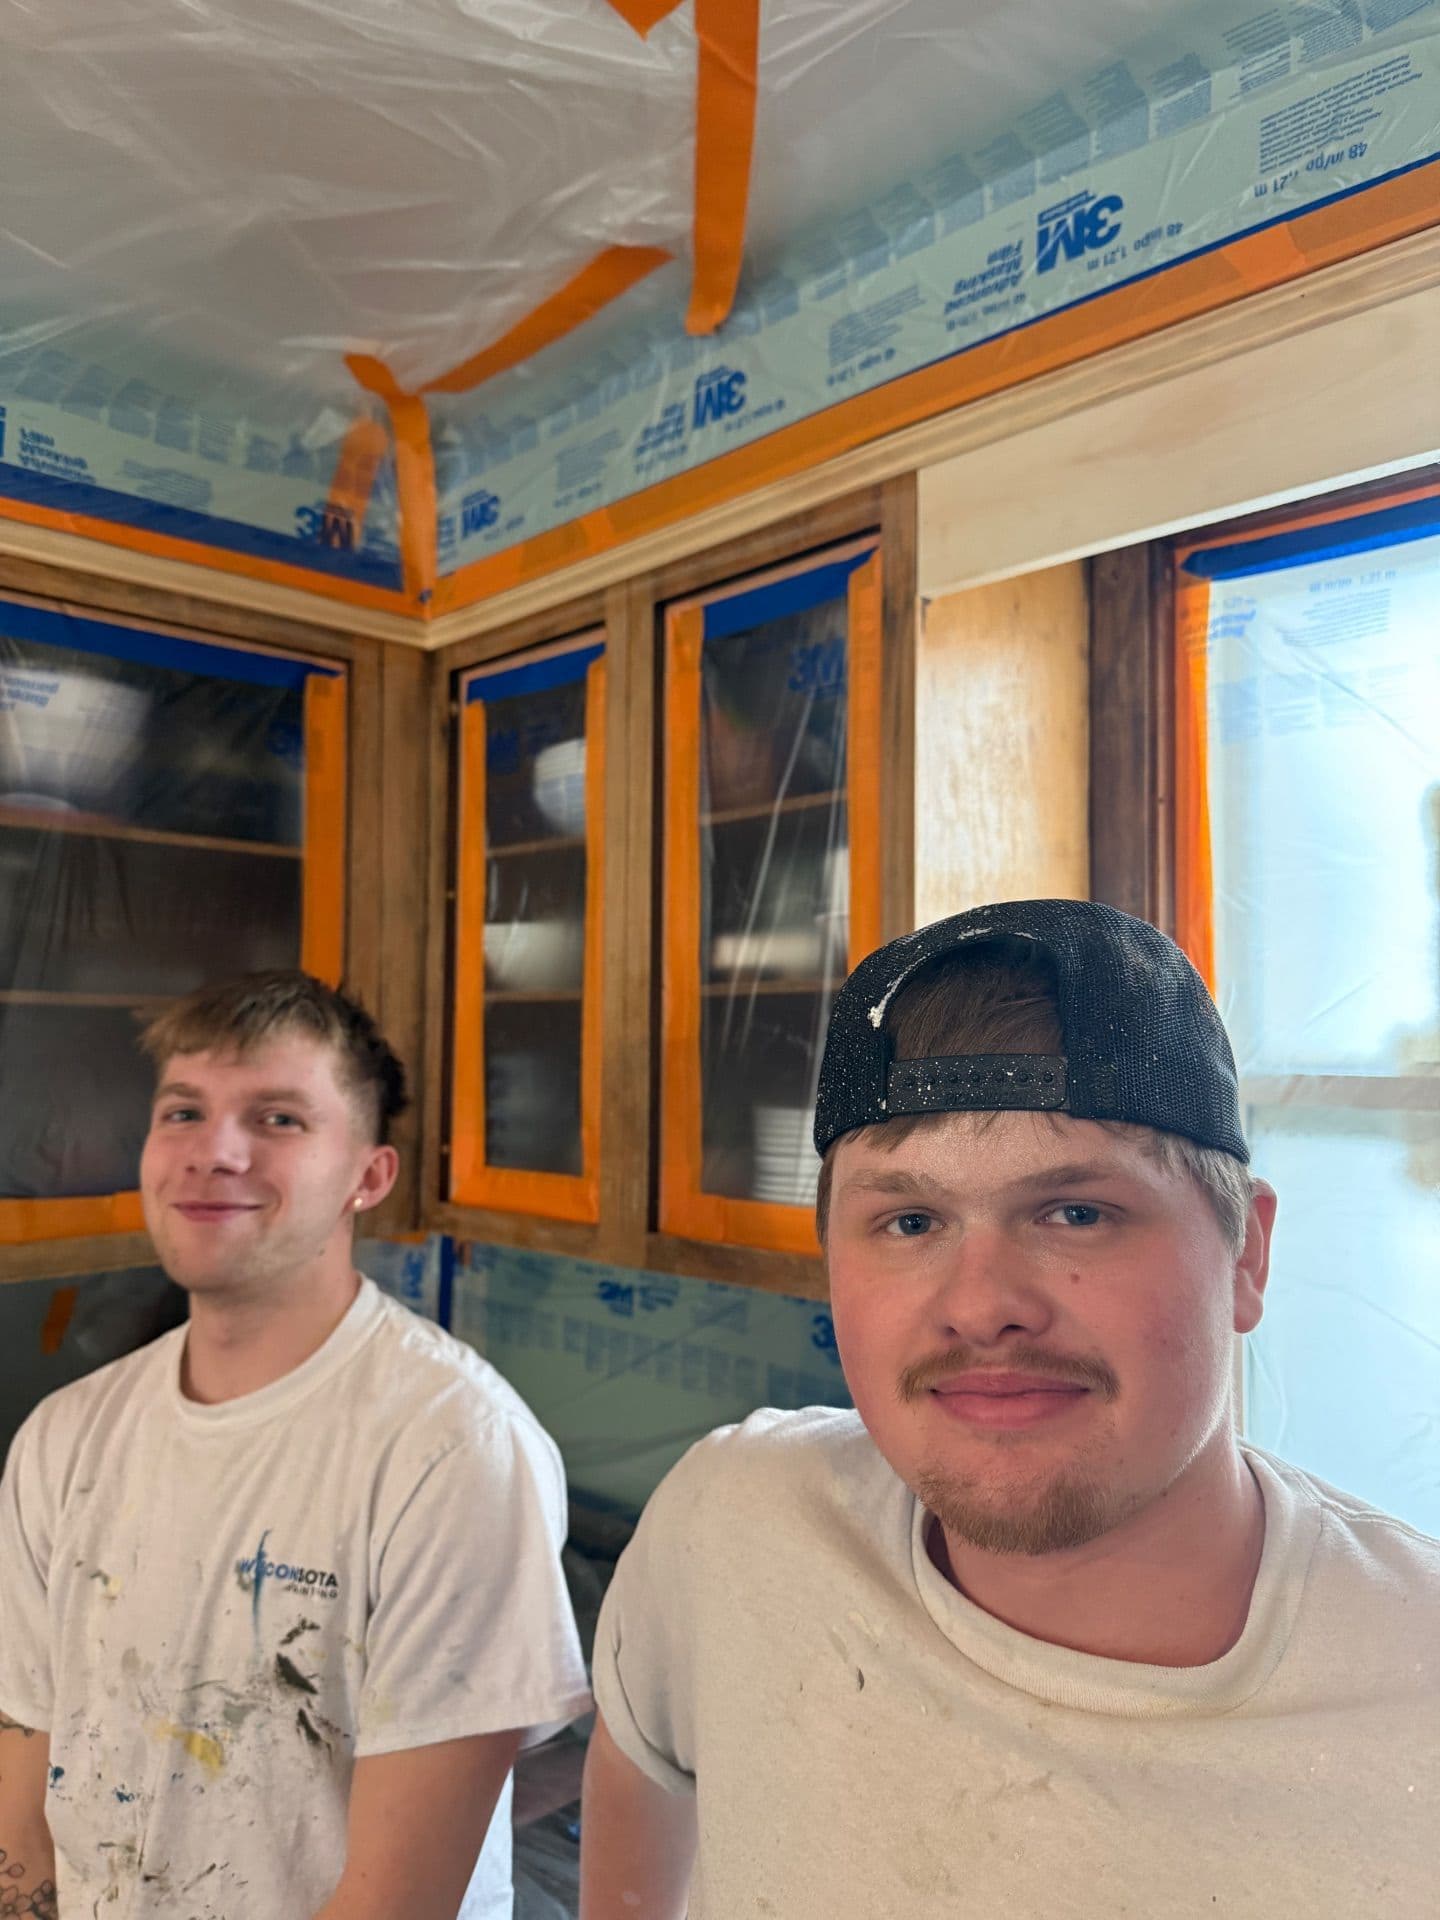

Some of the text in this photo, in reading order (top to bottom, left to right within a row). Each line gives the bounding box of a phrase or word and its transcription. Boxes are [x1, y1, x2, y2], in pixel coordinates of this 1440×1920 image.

[1305, 151, 1344, 171] in/po
[1348, 142, 1368, 159] 48
[1254, 183, 1268, 198] m
[1036, 194, 1123, 276] 3M
[943, 271, 1024, 316] Advanced
[953, 255, 1023, 296] Masking
[692, 371, 747, 429] 3M
[462, 495, 500, 540] 3M
